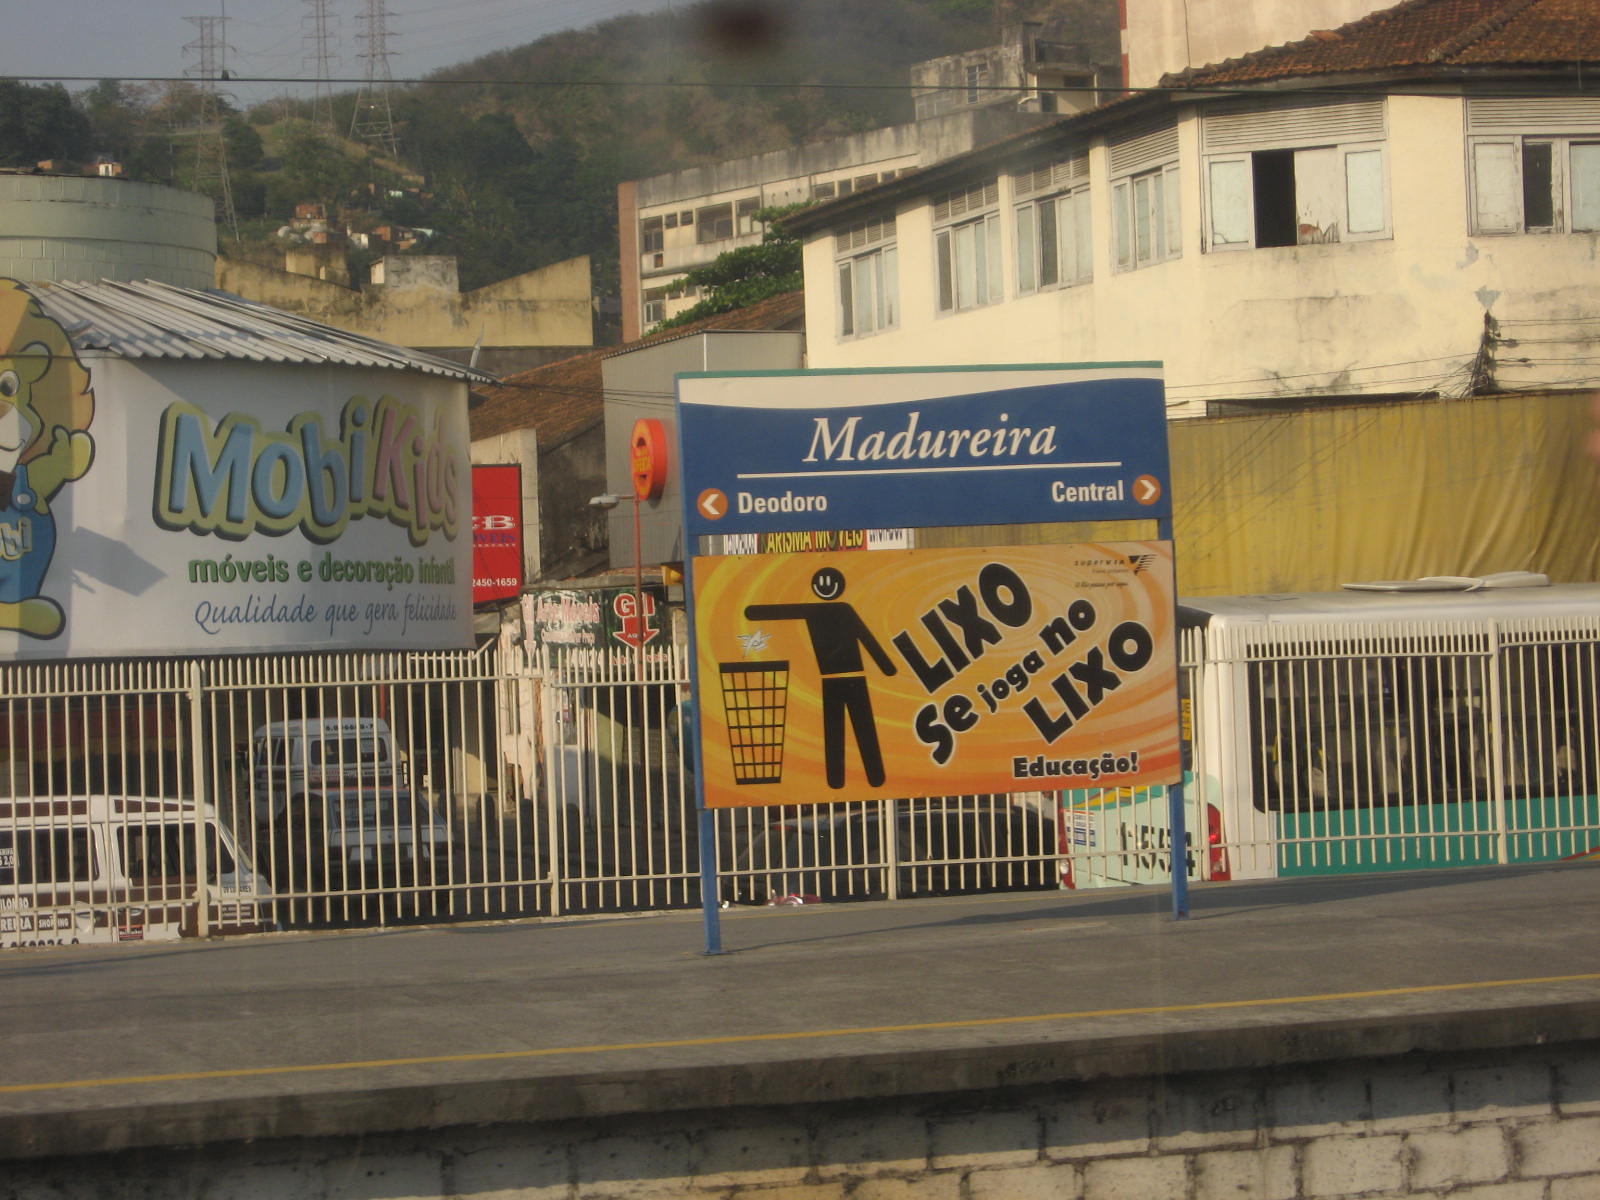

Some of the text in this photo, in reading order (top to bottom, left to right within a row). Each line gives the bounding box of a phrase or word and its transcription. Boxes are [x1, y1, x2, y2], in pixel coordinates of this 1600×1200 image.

[803, 411, 1057, 463] Madureira
[155, 396, 460, 545] MobiKids
[1051, 479, 1124, 504] Central
[737, 490, 828, 516] Deodoro
[188, 553, 290, 583] móveis
[296, 559, 314, 583] e
[319, 551, 414, 591] decoração
[195, 594, 317, 636] Qualidade
[323, 605, 359, 637] que
[362, 600, 399, 636] gera
[892, 562, 1032, 694] LIXO
[977, 650, 1046, 714] joga
[1038, 599, 1097, 656] no
[1022, 621, 1154, 745] LIXO
[1013, 751, 1139, 780] Educação!
